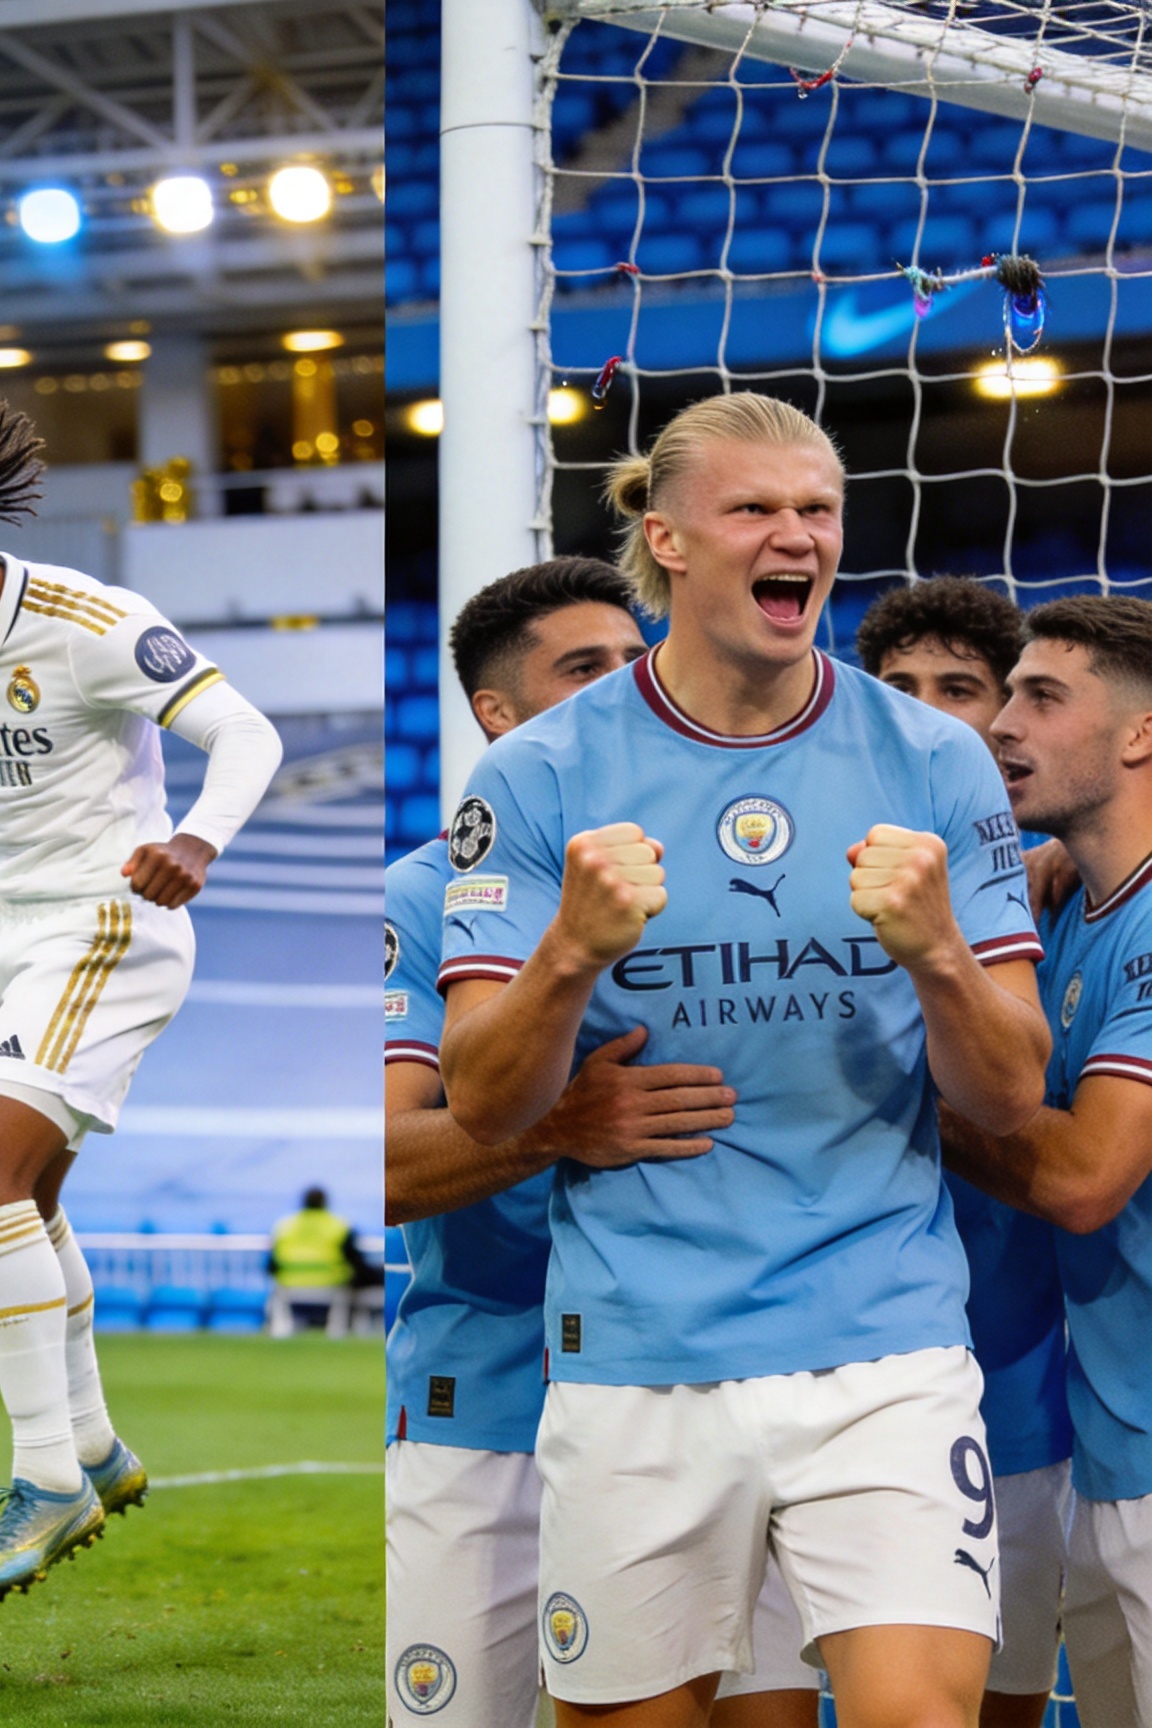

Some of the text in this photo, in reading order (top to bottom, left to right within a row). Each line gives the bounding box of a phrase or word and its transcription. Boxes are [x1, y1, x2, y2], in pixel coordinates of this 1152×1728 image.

[611, 936, 899, 991] ETIHAD
[671, 990, 857, 1029] AIRWAYS
[949, 1435, 994, 1539] 9
